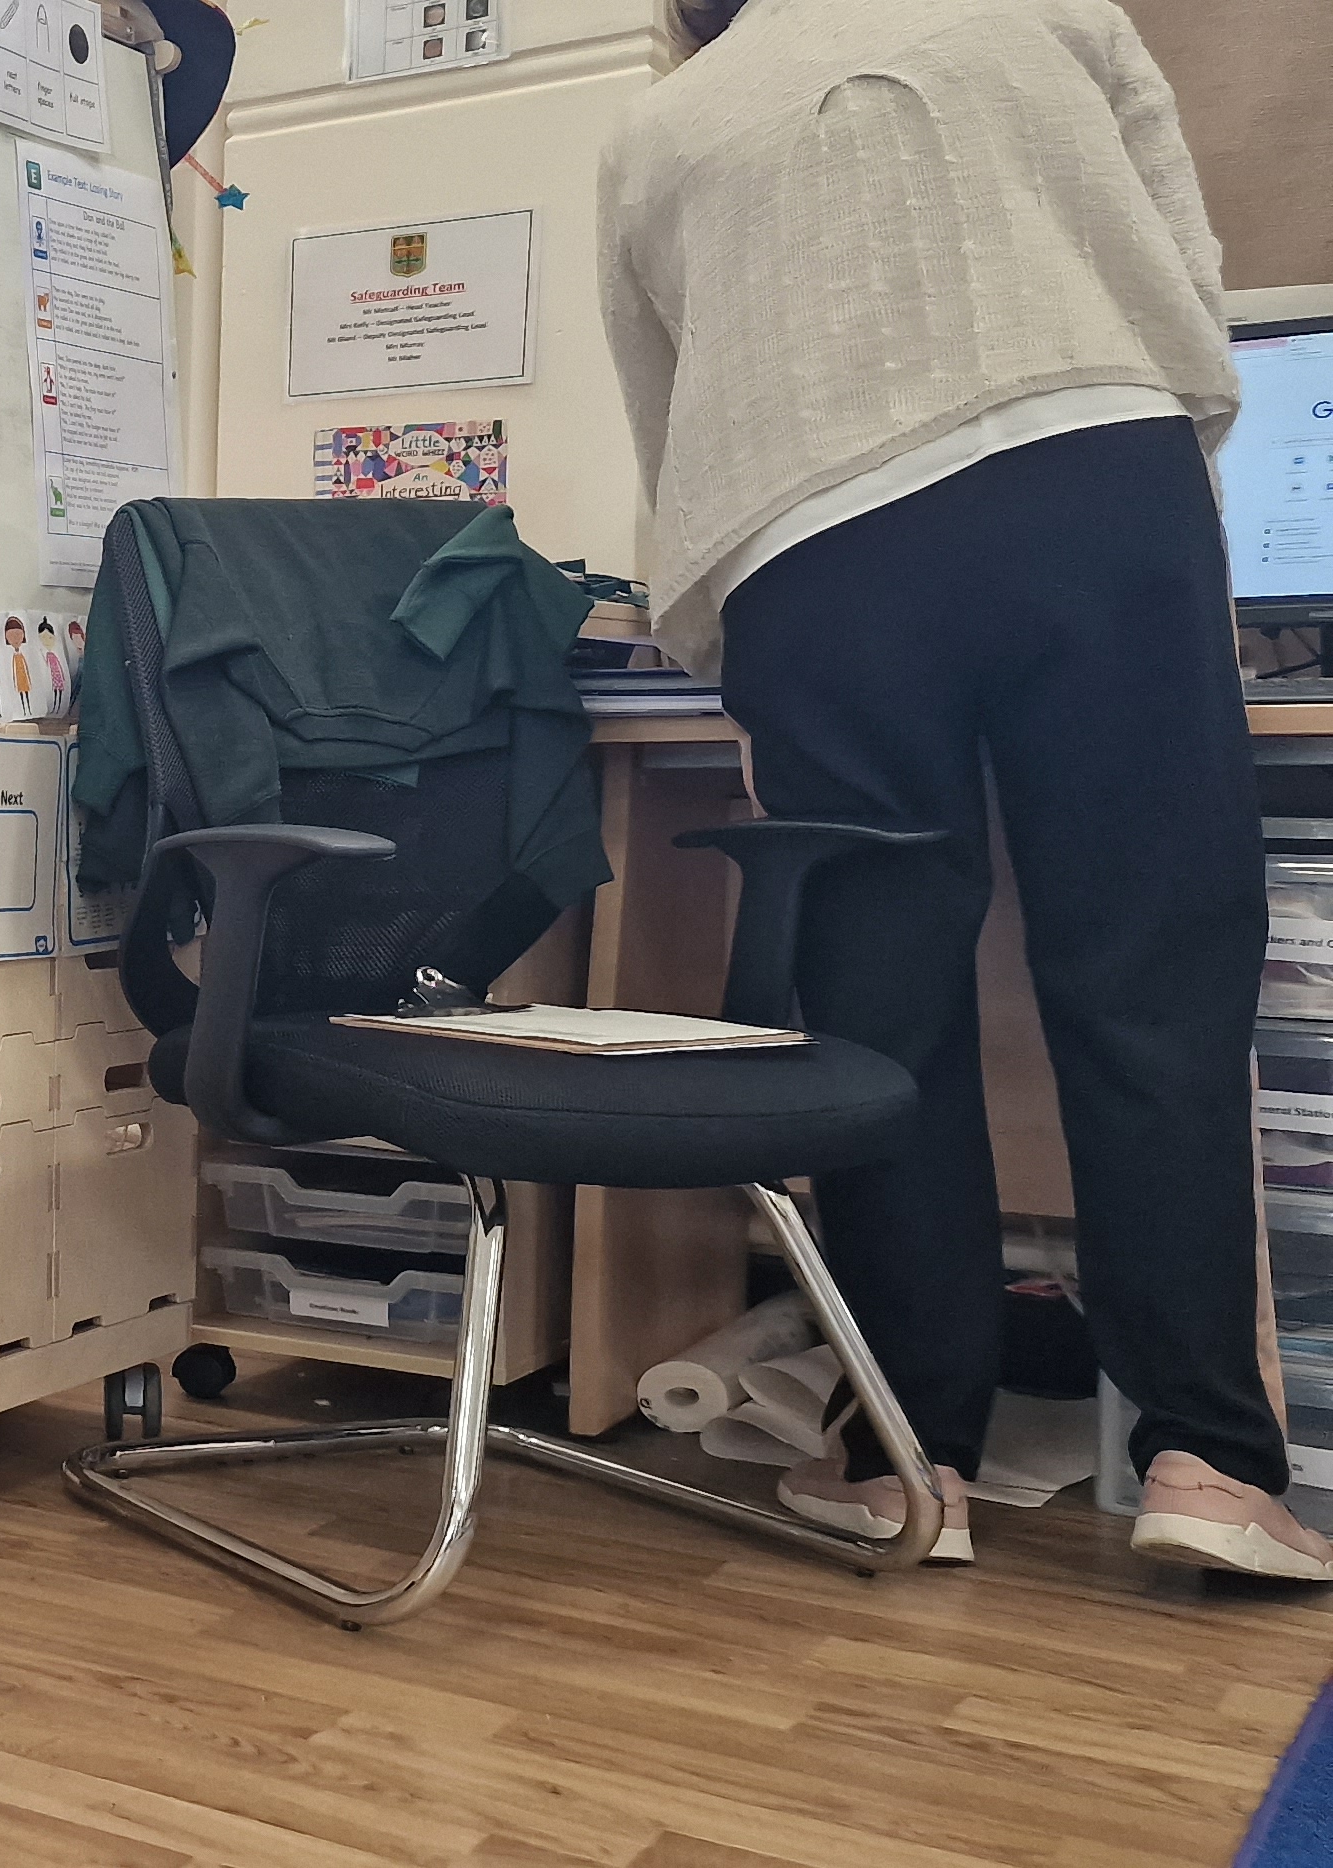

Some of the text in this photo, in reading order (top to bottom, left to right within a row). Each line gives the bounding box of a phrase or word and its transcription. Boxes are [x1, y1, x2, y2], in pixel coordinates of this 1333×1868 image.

[30, 169, 37, 184] E
[47, 170, 73, 187] Example
[350, 282, 466, 303] Safeguarding Team
[401, 434, 441, 449] Little
[413, 473, 429, 482] An
[380, 481, 462, 500] Interesting
[0, 790, 24, 806] Next
[1293, 1107, 1333, 1119] Statio
